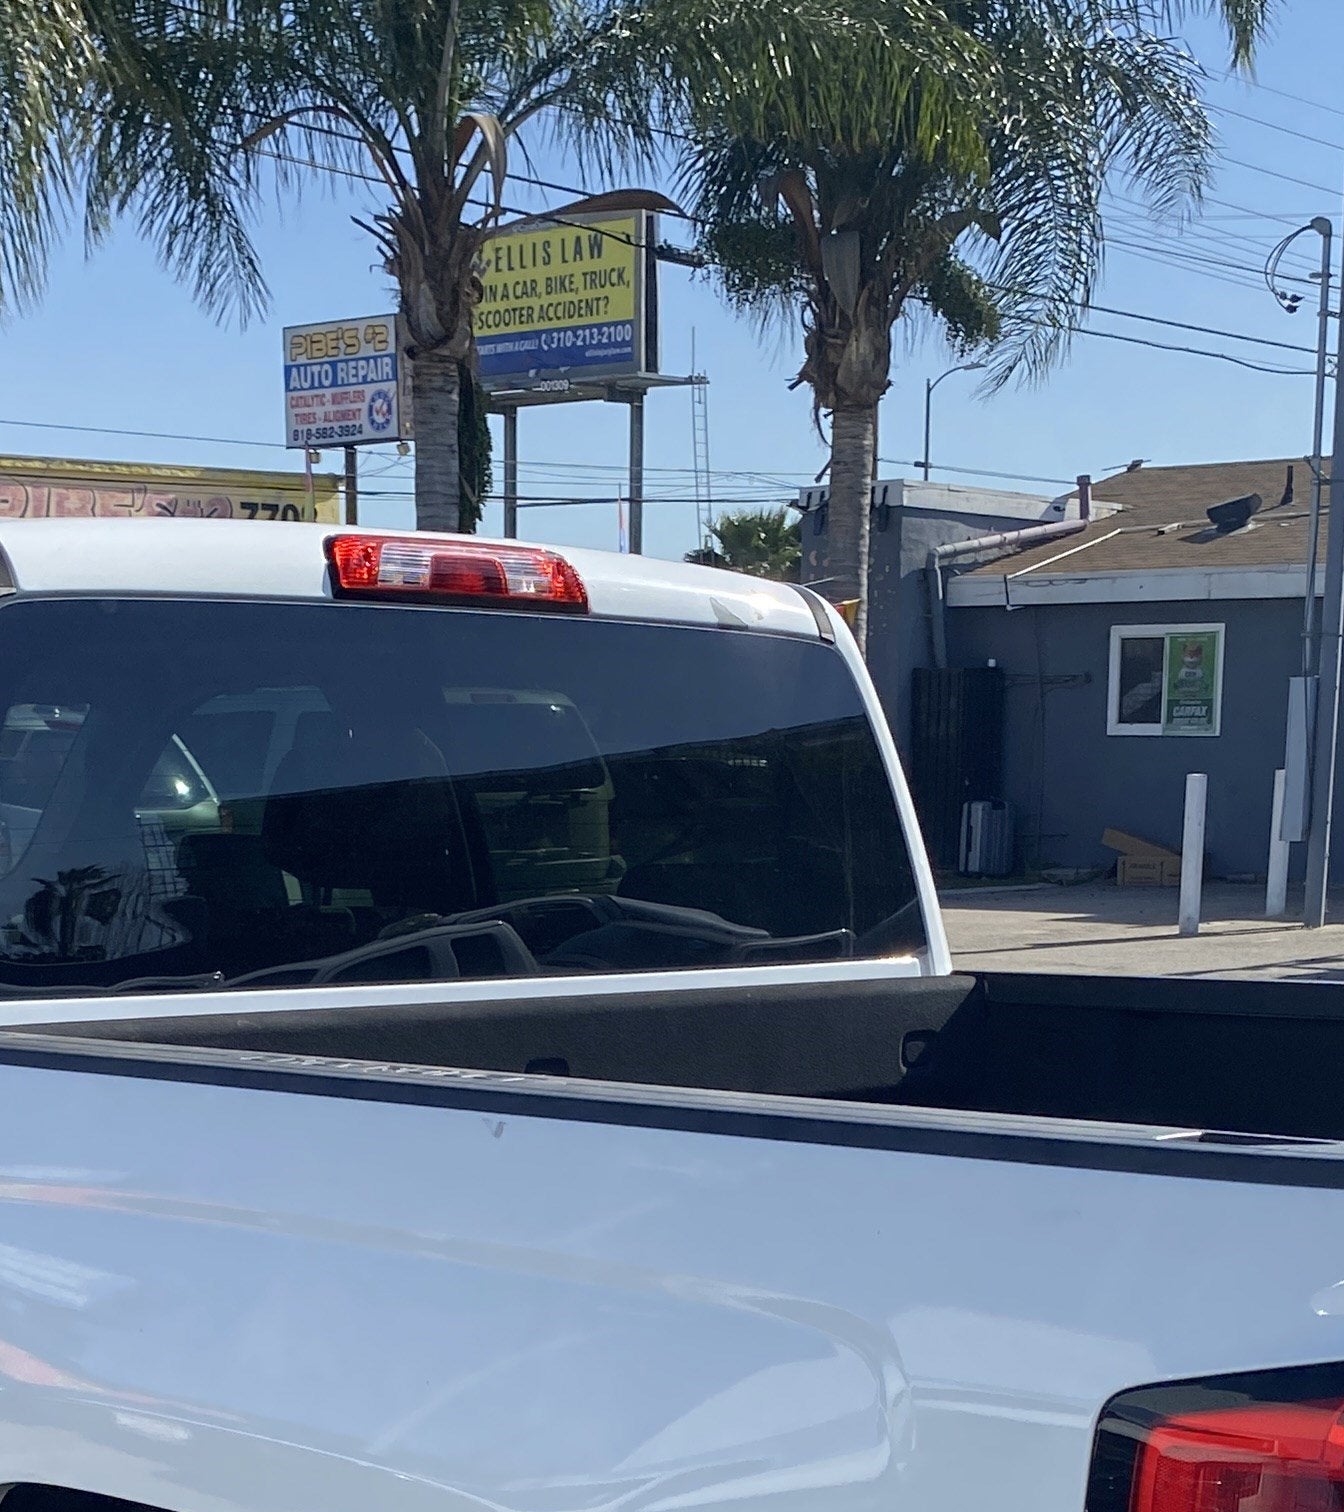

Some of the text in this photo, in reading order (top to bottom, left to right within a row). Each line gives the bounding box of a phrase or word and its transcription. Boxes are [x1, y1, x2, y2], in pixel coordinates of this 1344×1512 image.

[494, 233, 604, 273] ELLIS LAW
[500, 282, 510, 301] A
[513, 279, 542, 299] CAR,
[545, 273, 580, 296] BIKE,
[582, 266, 631, 291] TRUCK,
[537, 295, 610, 323] ACCIDENT?
[290, 327, 361, 361] PIBE'S
[550, 324, 633, 349] 310-213-2100
[289, 356, 393, 390] AUTO REPAIR
[294, 412, 317, 425] TIRES
[1173, 705, 1208, 717] CARFAX
